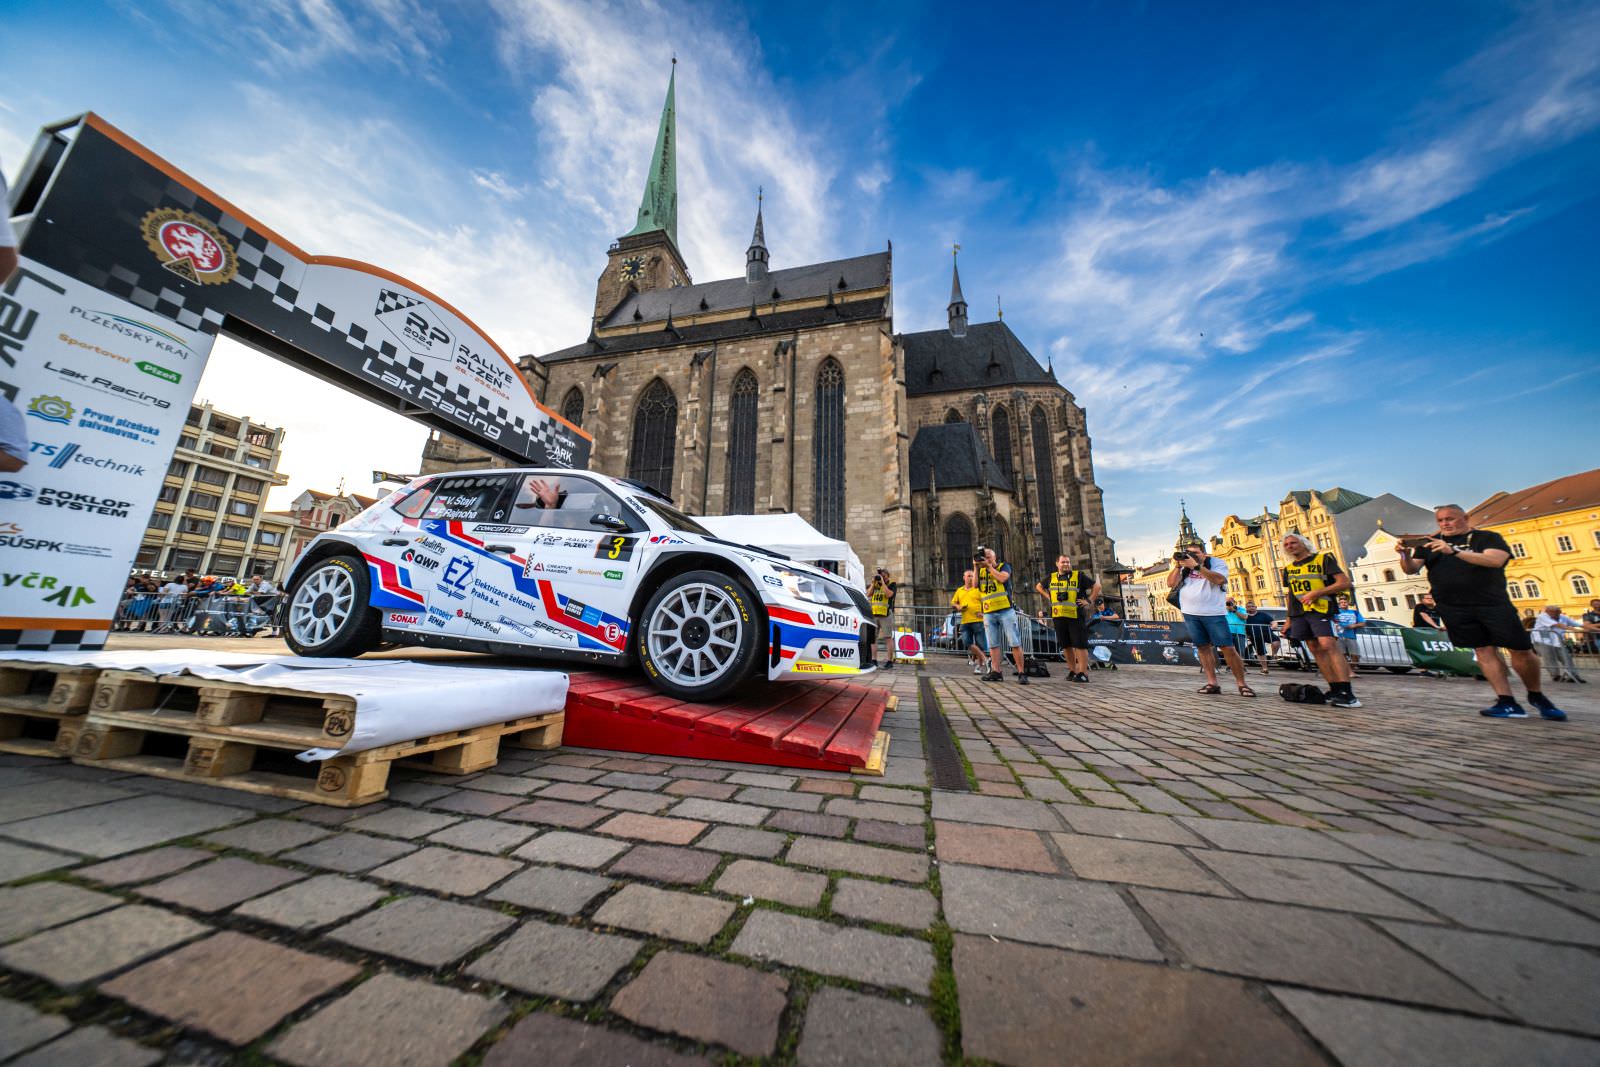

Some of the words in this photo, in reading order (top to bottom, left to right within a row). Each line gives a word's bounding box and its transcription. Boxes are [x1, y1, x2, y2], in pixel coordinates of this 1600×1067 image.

[403, 325, 433, 347] 2024
[405, 311, 450, 345] RP
[155, 340, 189, 360] KRAJ
[458, 344, 513, 384] RALLYE
[43, 361, 89, 382] Lak
[91, 376, 171, 409] Racing
[361, 357, 415, 395] Lak
[417, 386, 502, 441] Racing
[78, 418, 139, 441] galvanovna
[29, 441, 58, 456] TS
[73, 452, 147, 477] technik
[553, 445, 573, 463] ARK
[36, 496, 129, 518] SYSTEM
[39, 487, 132, 509] POKLOP
[0, 534, 64, 553] SÚSPK
[420, 536, 446, 554] AuditPro
[607, 536, 625, 559] 3
[414, 553, 440, 570] QWP
[442, 555, 475, 591] EŽ
[470, 587, 490, 602] Praha
[474, 577, 508, 599] Elektrizace
[508, 592, 537, 612] železnic
[390, 613, 419, 625] SONAX
[463, 611, 484, 628] Shape
[483, 620, 502, 635] Steel
[817, 609, 850, 627] dator
[608, 625, 617, 639] E
[830, 647, 855, 658] QWP
[1421, 640, 1455, 652] LESY
[795, 663, 824, 672] PIRELLI
